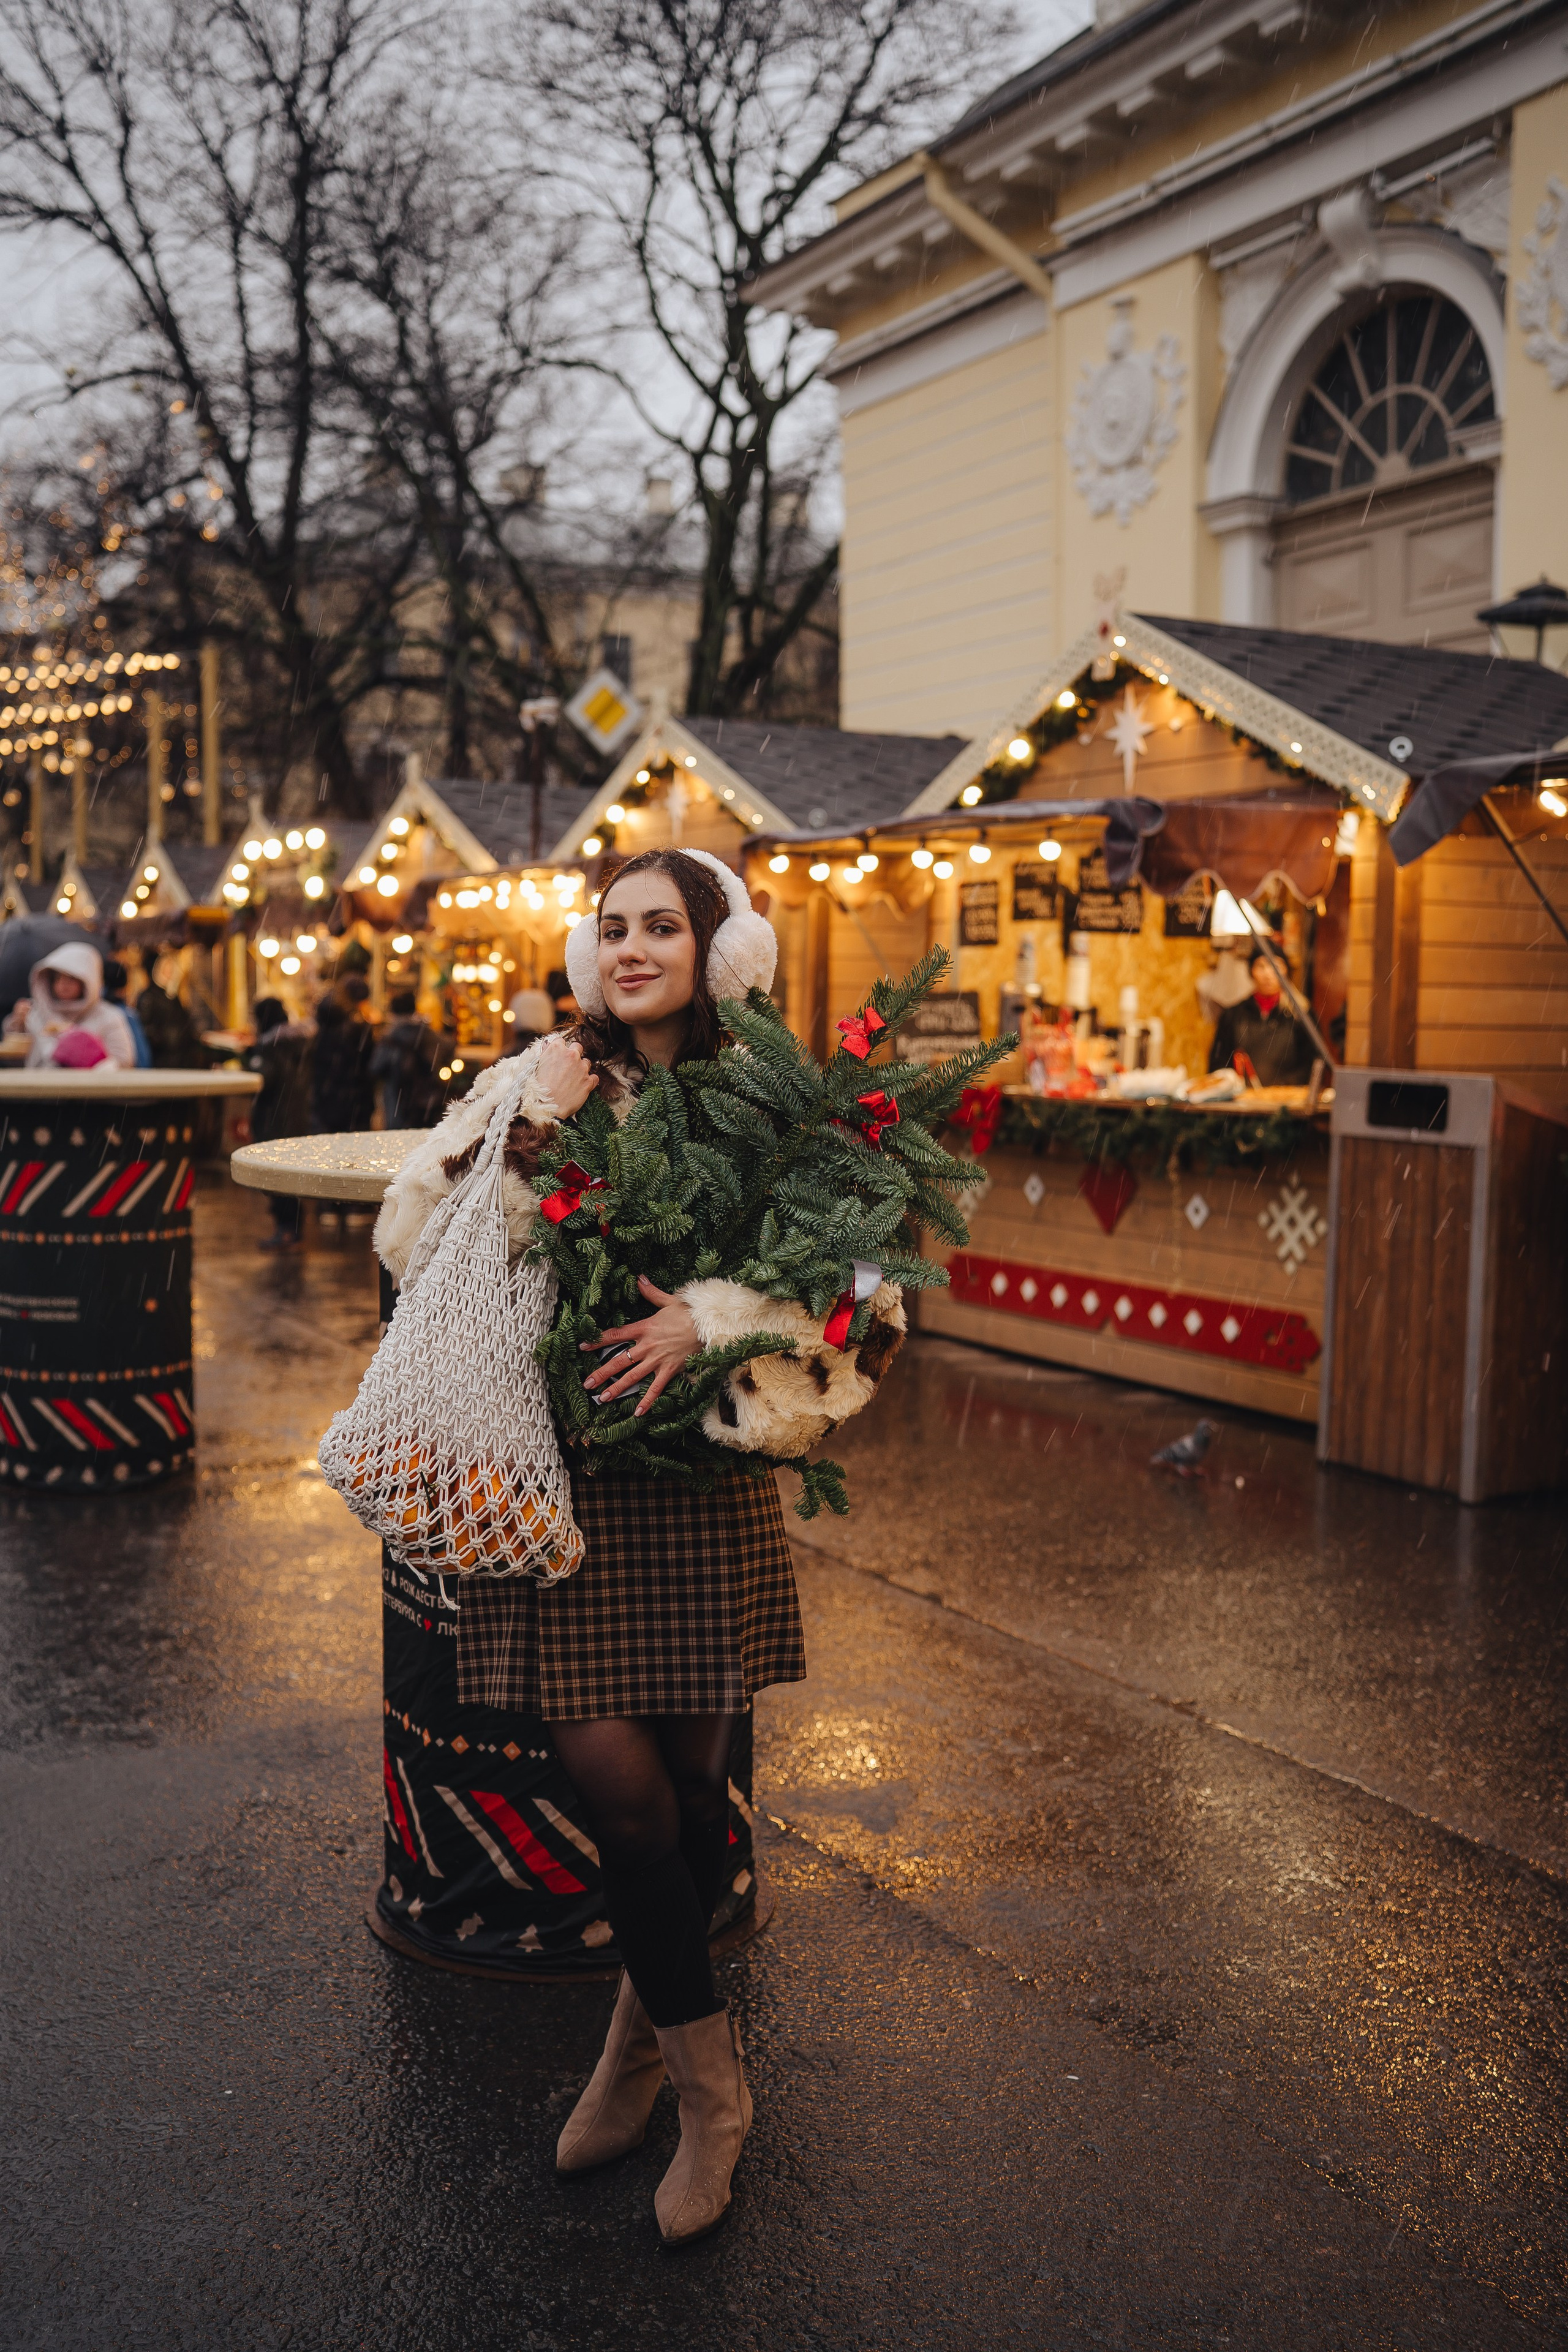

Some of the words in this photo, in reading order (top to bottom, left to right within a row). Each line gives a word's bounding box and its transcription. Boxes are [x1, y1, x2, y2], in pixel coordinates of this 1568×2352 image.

[383, 1591, 415, 1624] ЕТЕРБУРГА
[417, 1613, 422, 1627] С
[399, 1576, 455, 1609] РОЖДЕСТВ
